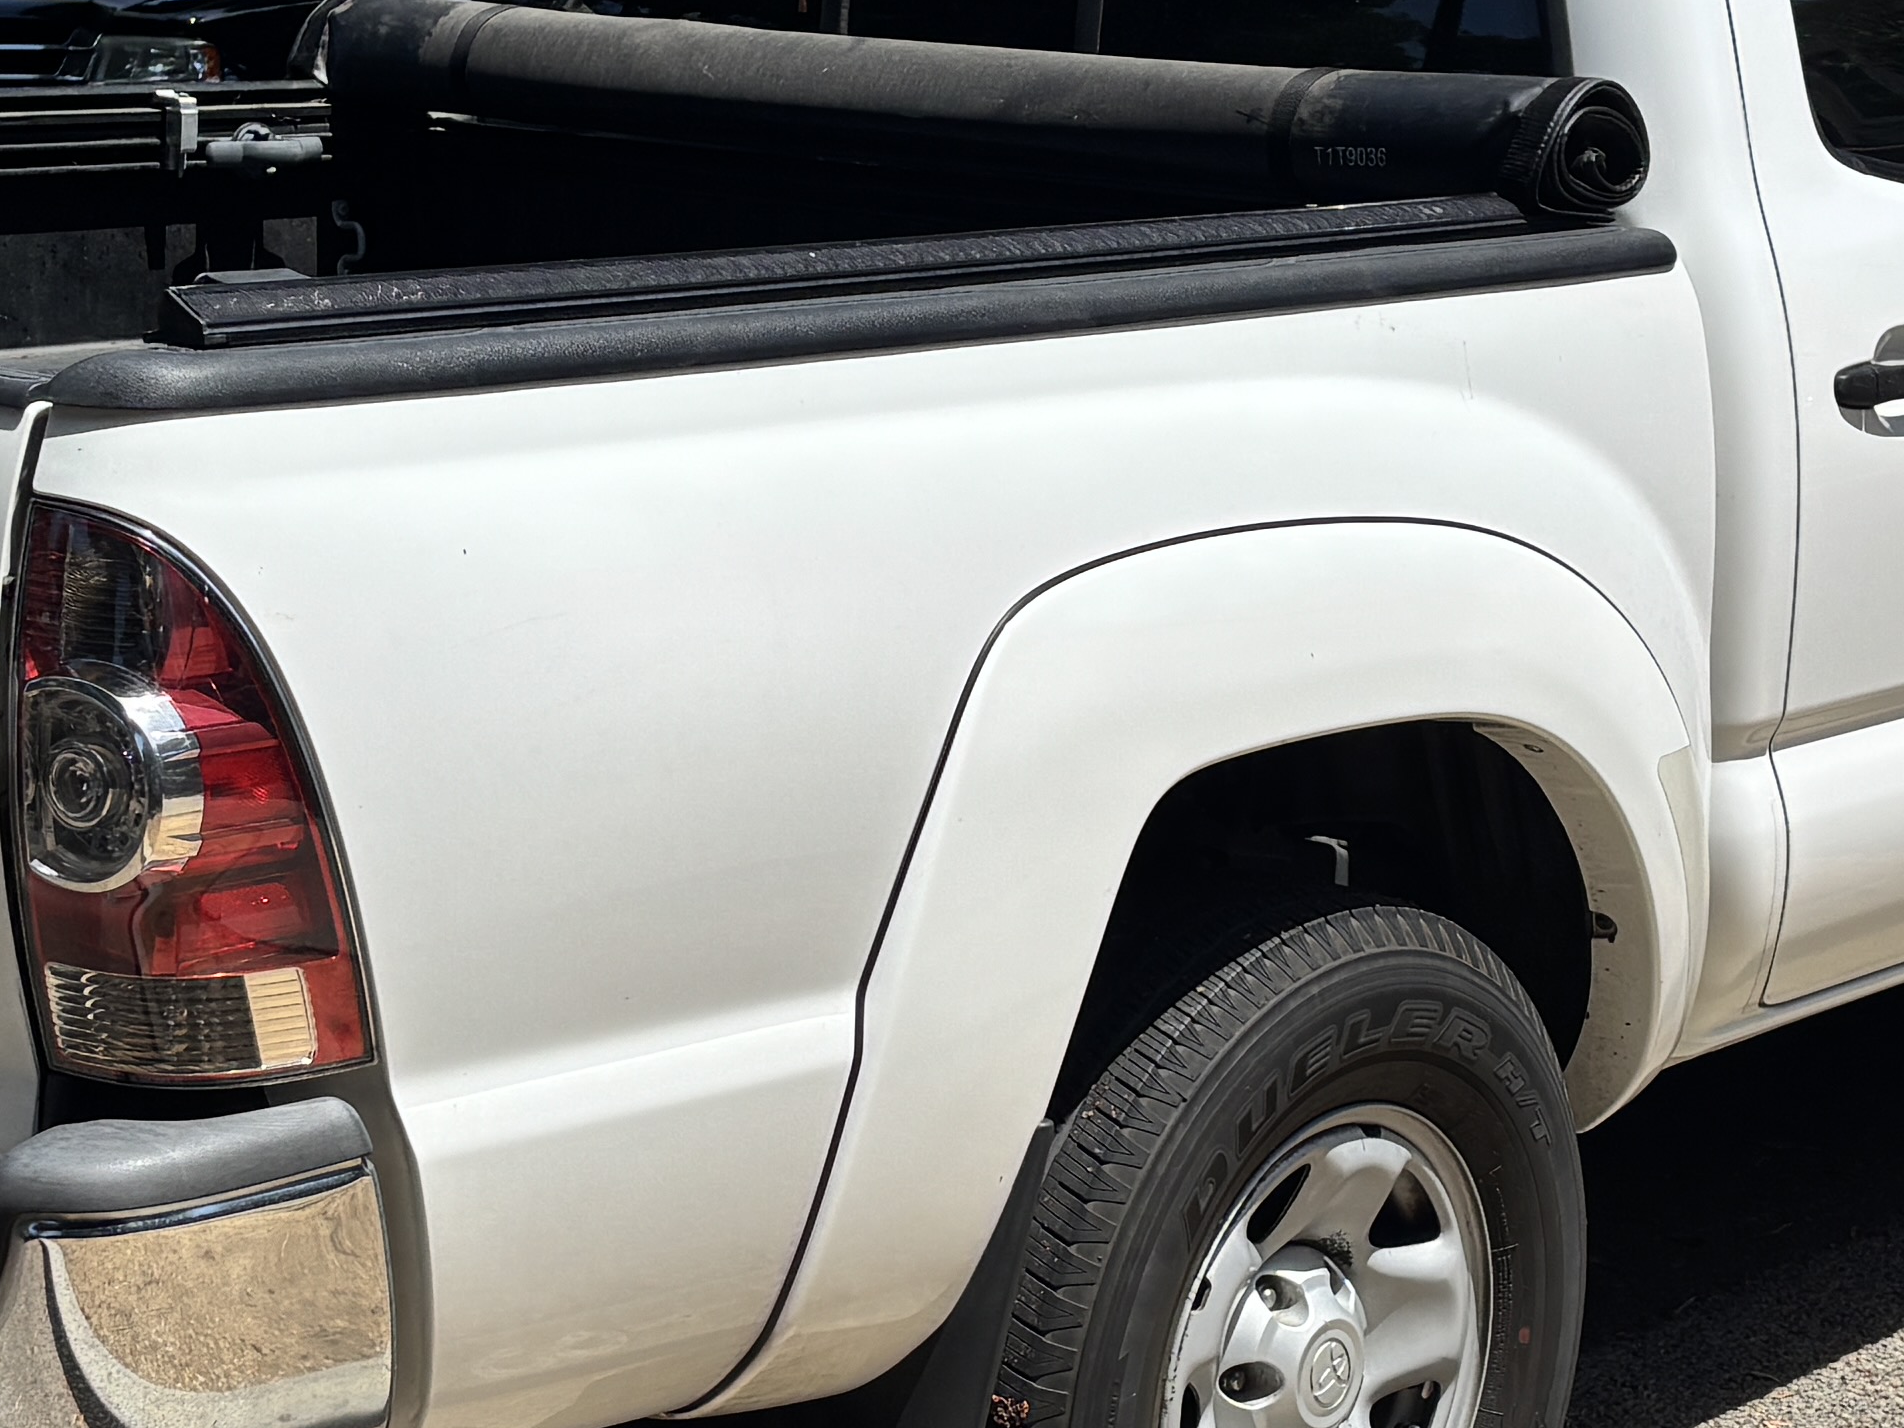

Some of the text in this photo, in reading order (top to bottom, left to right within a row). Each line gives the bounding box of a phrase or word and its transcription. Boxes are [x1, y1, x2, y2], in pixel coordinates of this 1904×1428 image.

[1313, 146, 1387, 167] T1T9036
[1181, 998, 1554, 1254] DUELER H/T
